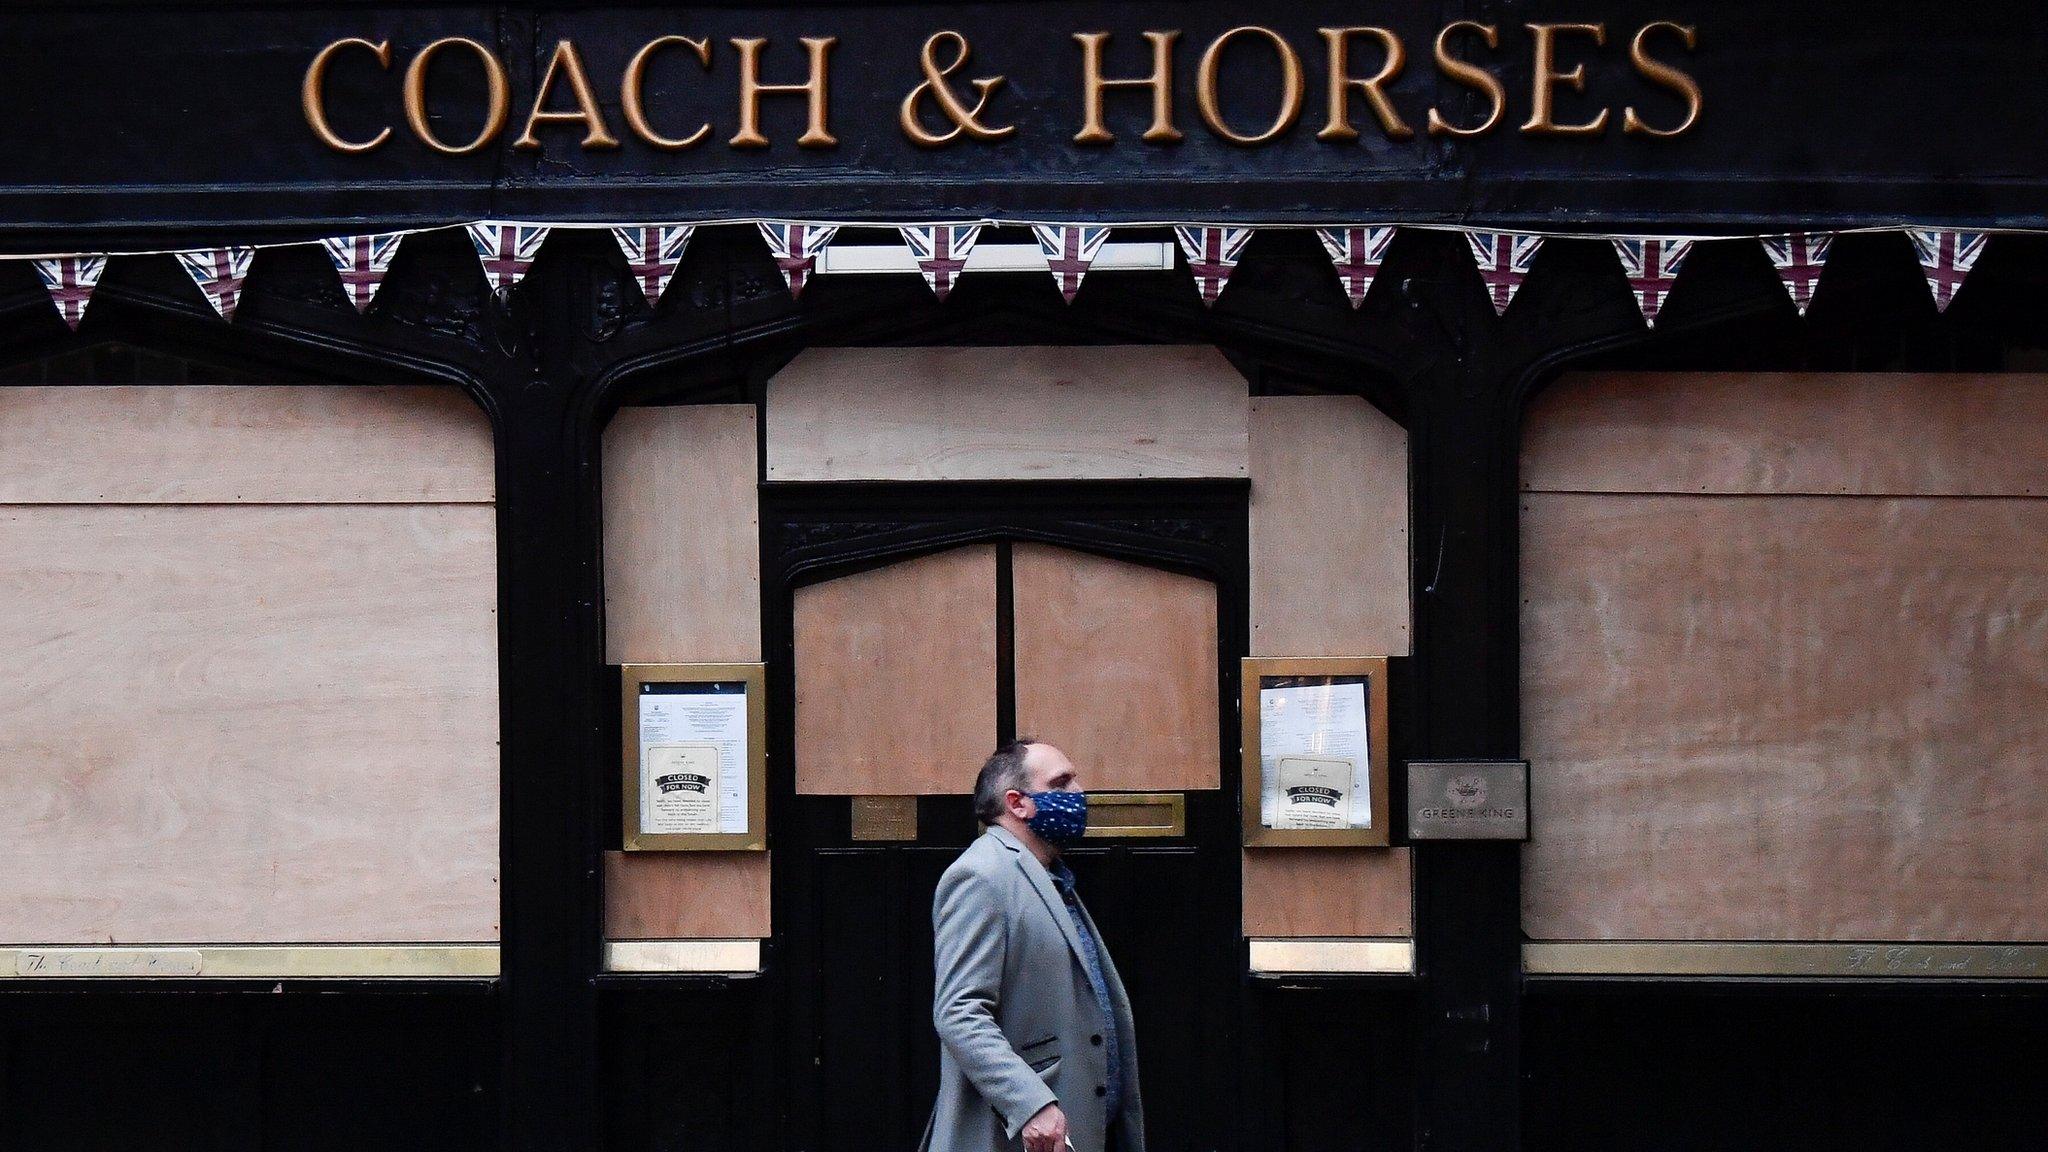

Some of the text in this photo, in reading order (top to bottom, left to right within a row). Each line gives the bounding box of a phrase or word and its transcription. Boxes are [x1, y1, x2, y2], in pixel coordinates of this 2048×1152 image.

[302, 19, 1702, 153] COACH & HORSES
[667, 774, 699, 782] CLOSED
[1298, 786, 1331, 795] CLOSED
[1311, 796, 1331, 804] NOW
[1421, 808, 1514, 819] GREENE KING
